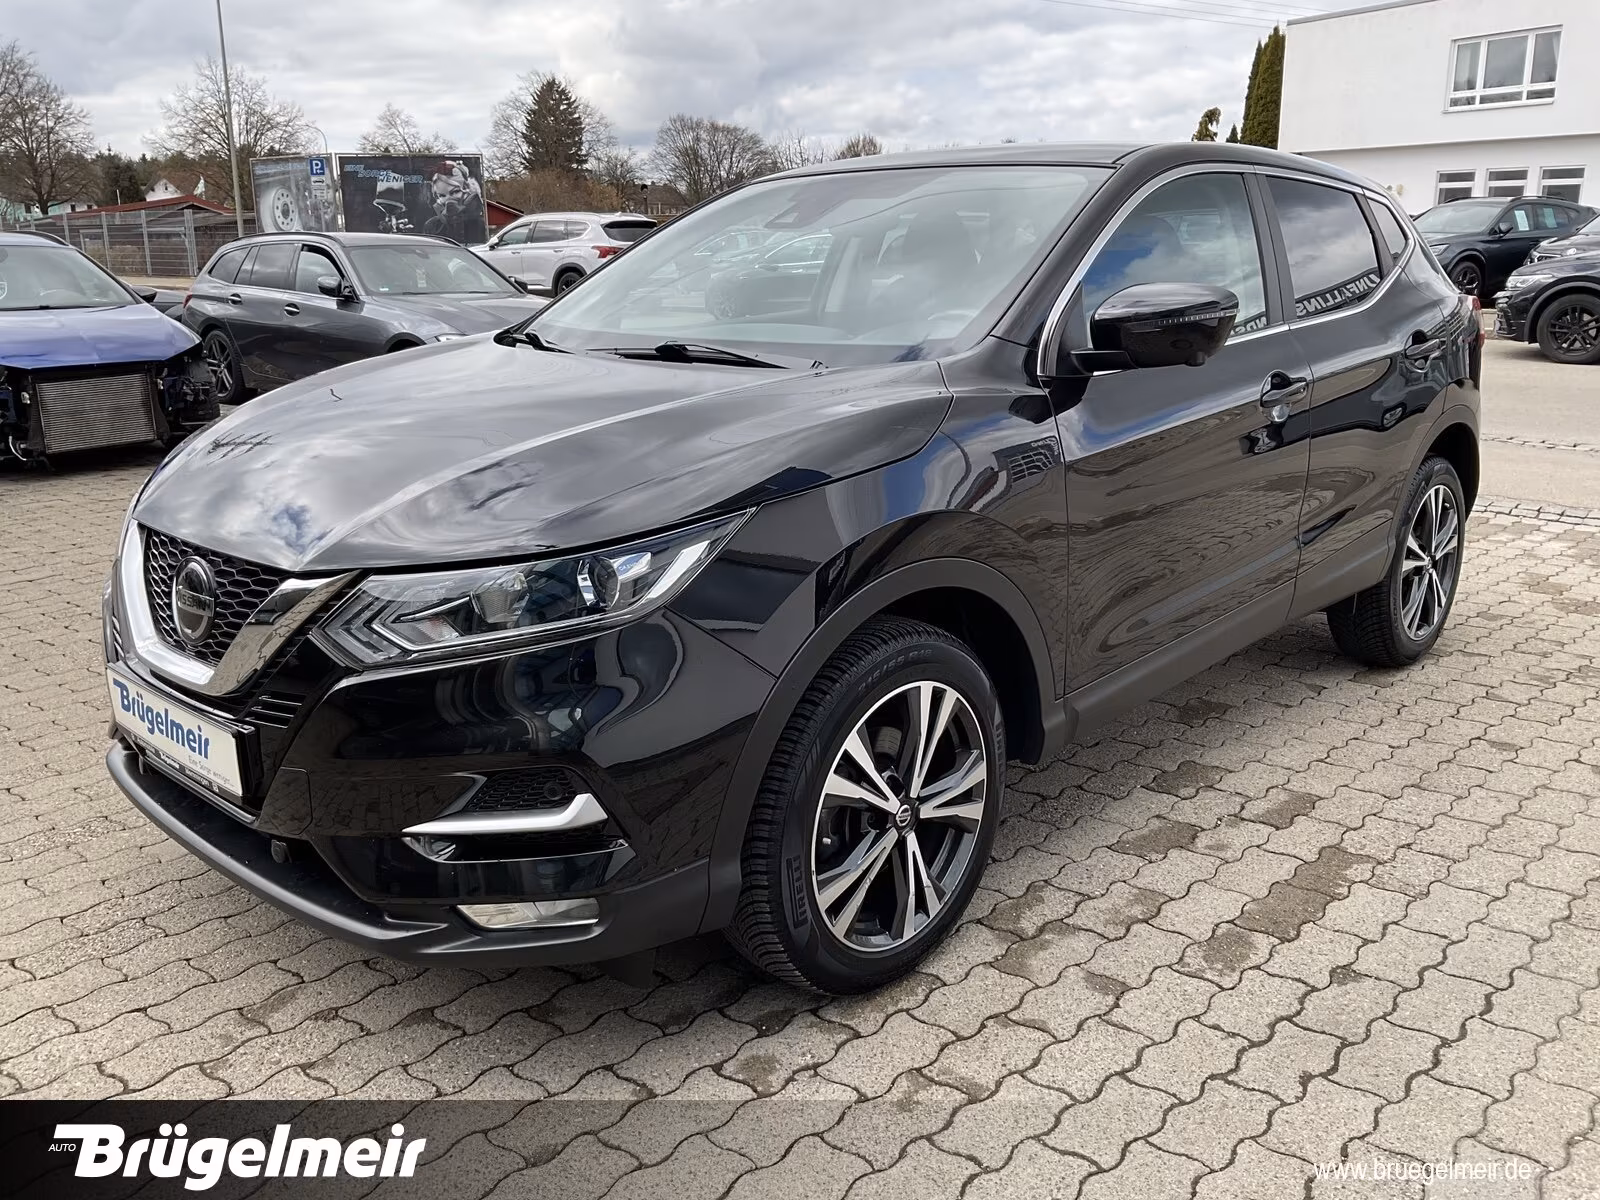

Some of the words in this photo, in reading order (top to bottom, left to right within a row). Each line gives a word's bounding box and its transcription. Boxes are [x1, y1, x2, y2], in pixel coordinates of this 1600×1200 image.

[312, 160, 322, 174] P
[357, 169, 392, 178] SORGE
[113, 678, 211, 760] Brügelmeir
[785, 854, 809, 929] PIRELLI
